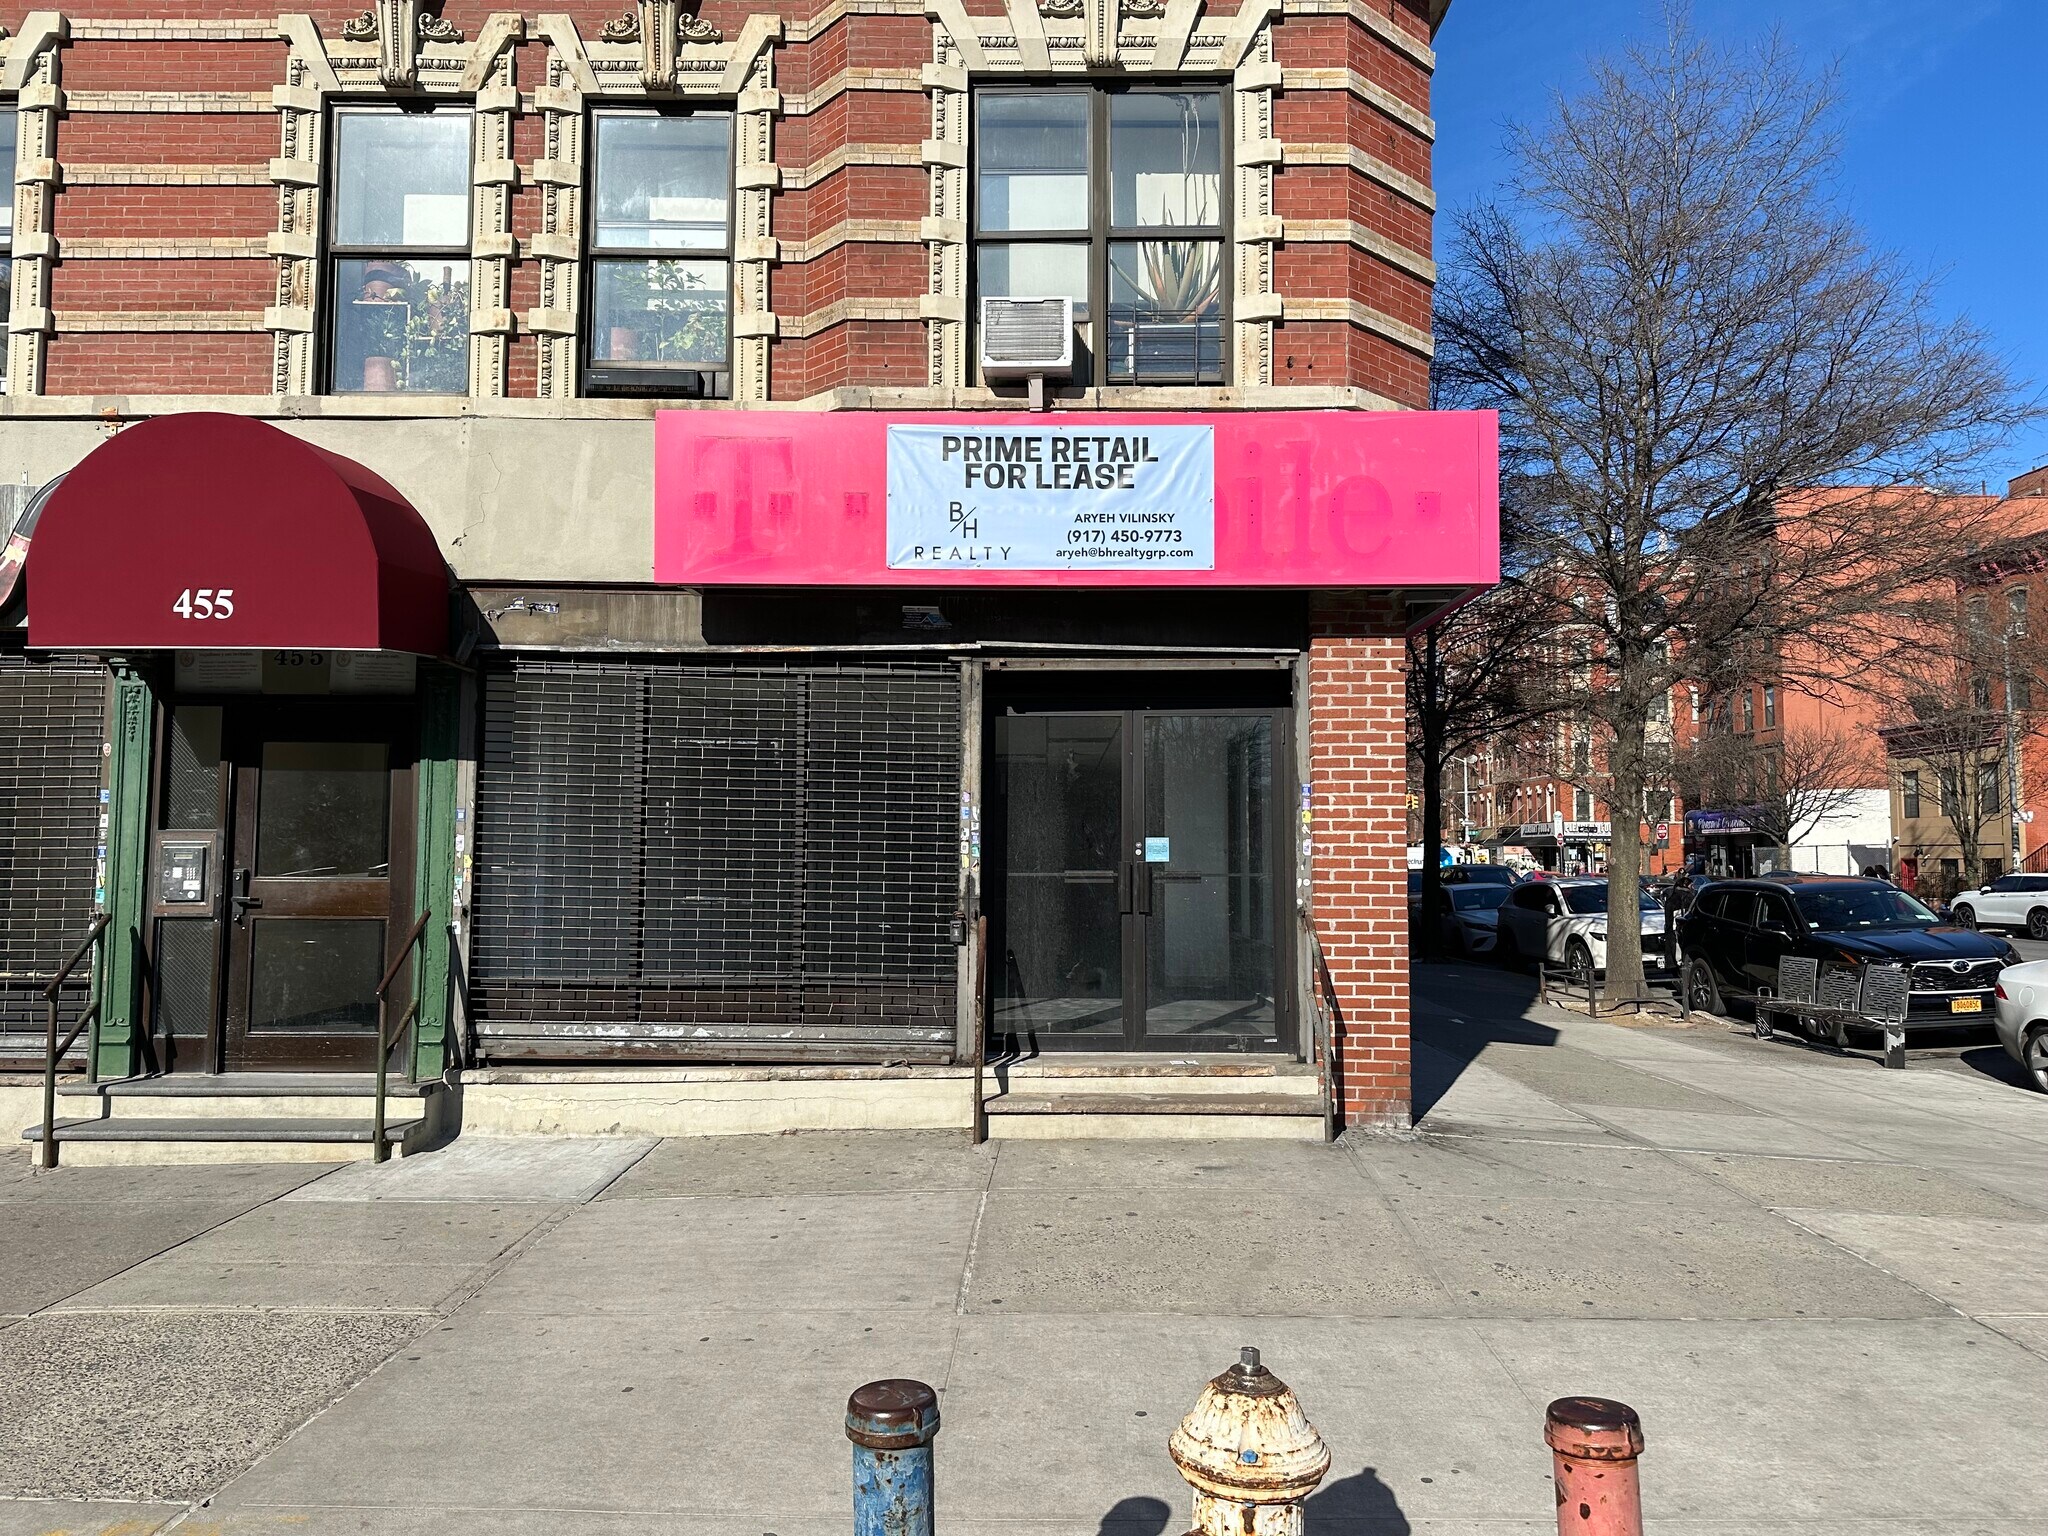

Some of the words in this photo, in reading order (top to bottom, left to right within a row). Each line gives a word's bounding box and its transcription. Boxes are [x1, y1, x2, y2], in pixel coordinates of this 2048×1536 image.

[942, 436, 1043, 463] PRIME
[1051, 436, 1159, 463] RETAIL
[965, 463, 1027, 489] FOR
[1036, 463, 1135, 489] LEASE
[1074, 513, 1116, 524] ARYEH
[1119, 513, 1176, 524] VILINSKY
[1067, 529, 1106, 544] (917)
[1110, 529, 1183, 543] 450-9773
[914, 546, 1012, 560] REALTY
[1055, 547, 1194, 560] aryeh@bhrealtygrp.com
[172, 588, 234, 620] 455
